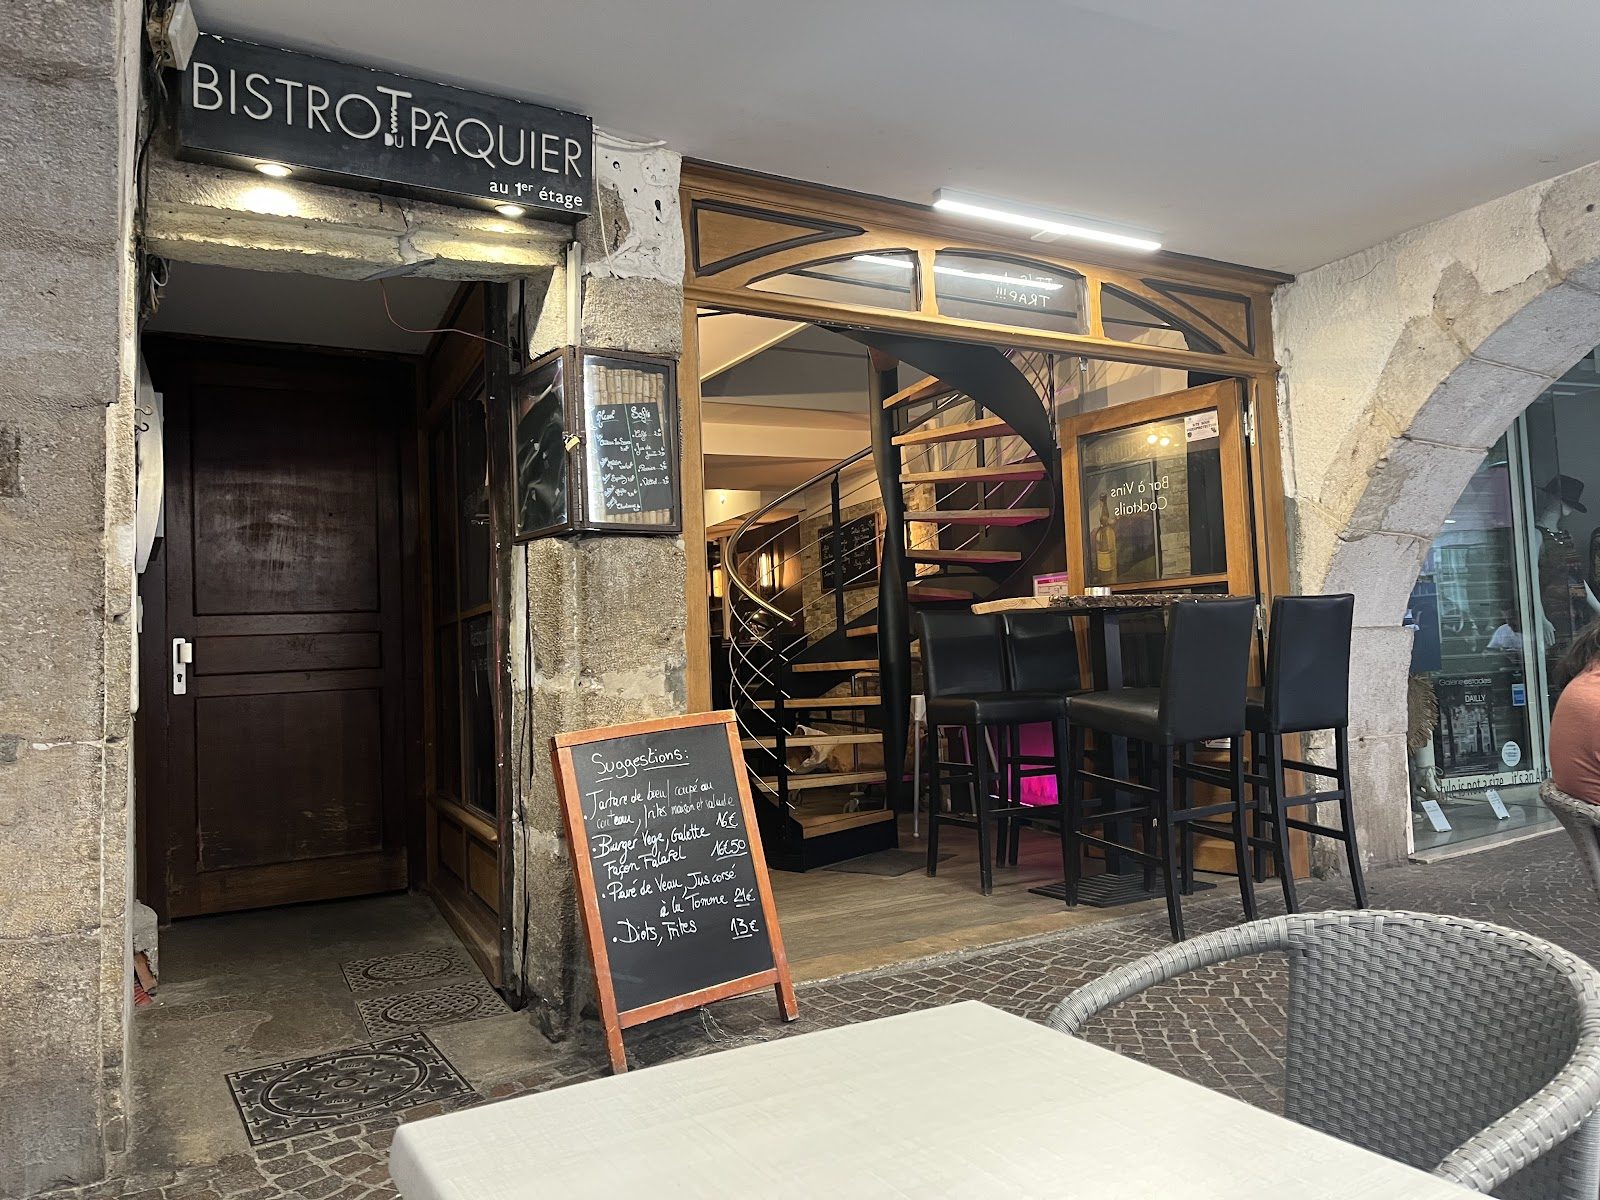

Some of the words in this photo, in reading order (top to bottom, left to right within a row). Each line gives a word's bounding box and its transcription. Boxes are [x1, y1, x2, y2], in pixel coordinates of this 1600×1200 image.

[193, 61, 412, 140] BISTROT
[411, 106, 582, 178] PÂQUIER
[489, 181, 508, 194] au
[514, 182, 534, 196] 1er
[539, 186, 583, 209] étage
[585, 788, 628, 821] Tartare
[630, 788, 644, 804] de
[700, 781, 714, 792] au
[671, 802, 696, 816] maison
[696, 798, 704, 811] et
[591, 833, 639, 865] Burger
[670, 823, 711, 843] Galette
[603, 860, 640, 880] Façon
[638, 845, 687, 870] Falafel
[606, 878, 638, 902] Pavé
[640, 879, 653, 896] de
[687, 870, 711, 889] Jus
[711, 864, 738, 884] corsé
[660, 899, 670, 918] à
[672, 895, 685, 914] la
[685, 892, 729, 911] Tomme
[733, 887, 756, 903] 21€
[662, 916, 698, 940] Frites
[730, 917, 760, 936] 13€
